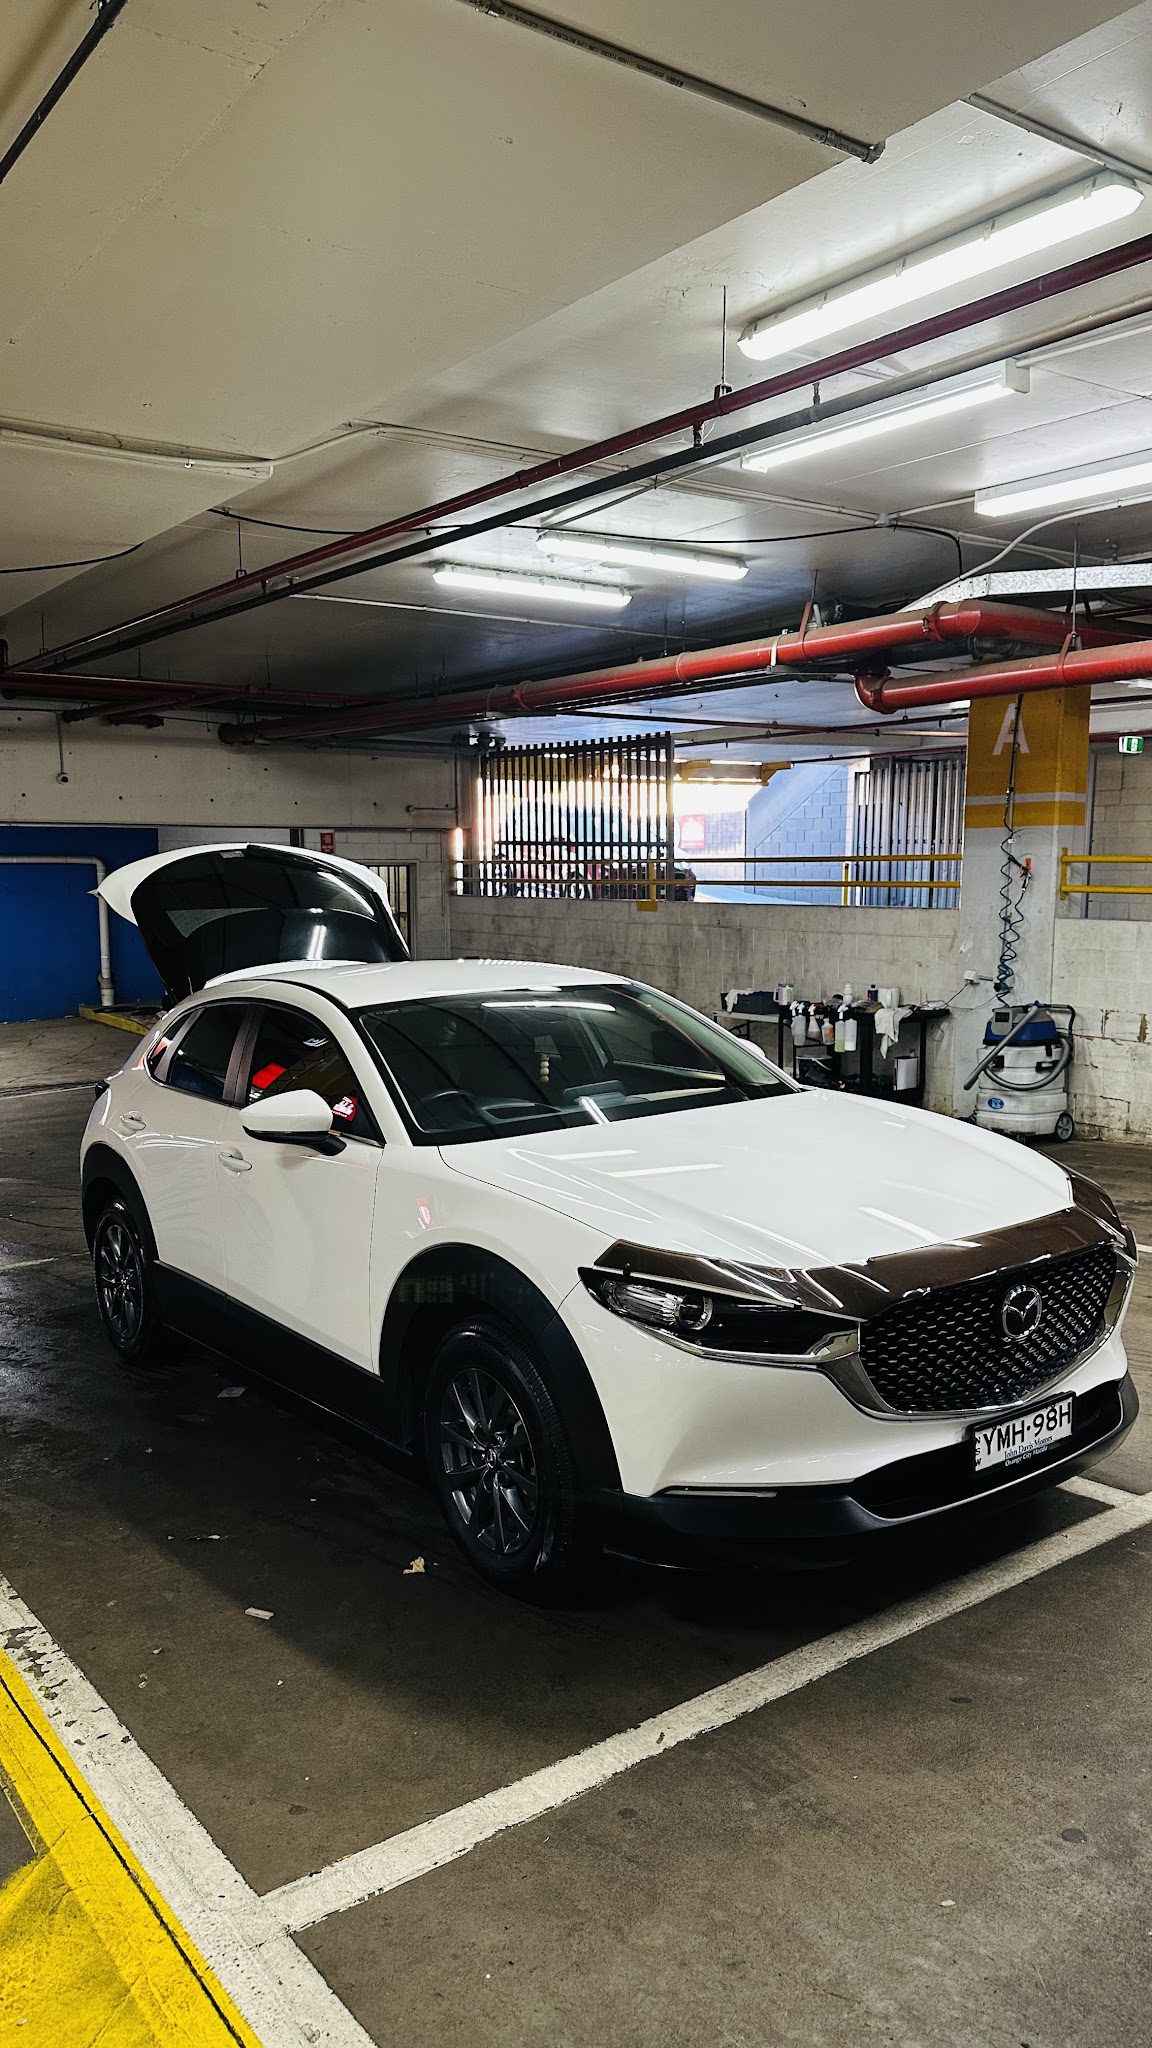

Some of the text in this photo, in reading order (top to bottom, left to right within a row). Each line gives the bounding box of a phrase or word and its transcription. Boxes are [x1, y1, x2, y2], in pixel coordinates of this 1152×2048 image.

[992, 703, 1030, 755] A
[1004, 1448, 1017, 1460] John
[1019, 1443, 1033, 1453] Davis
